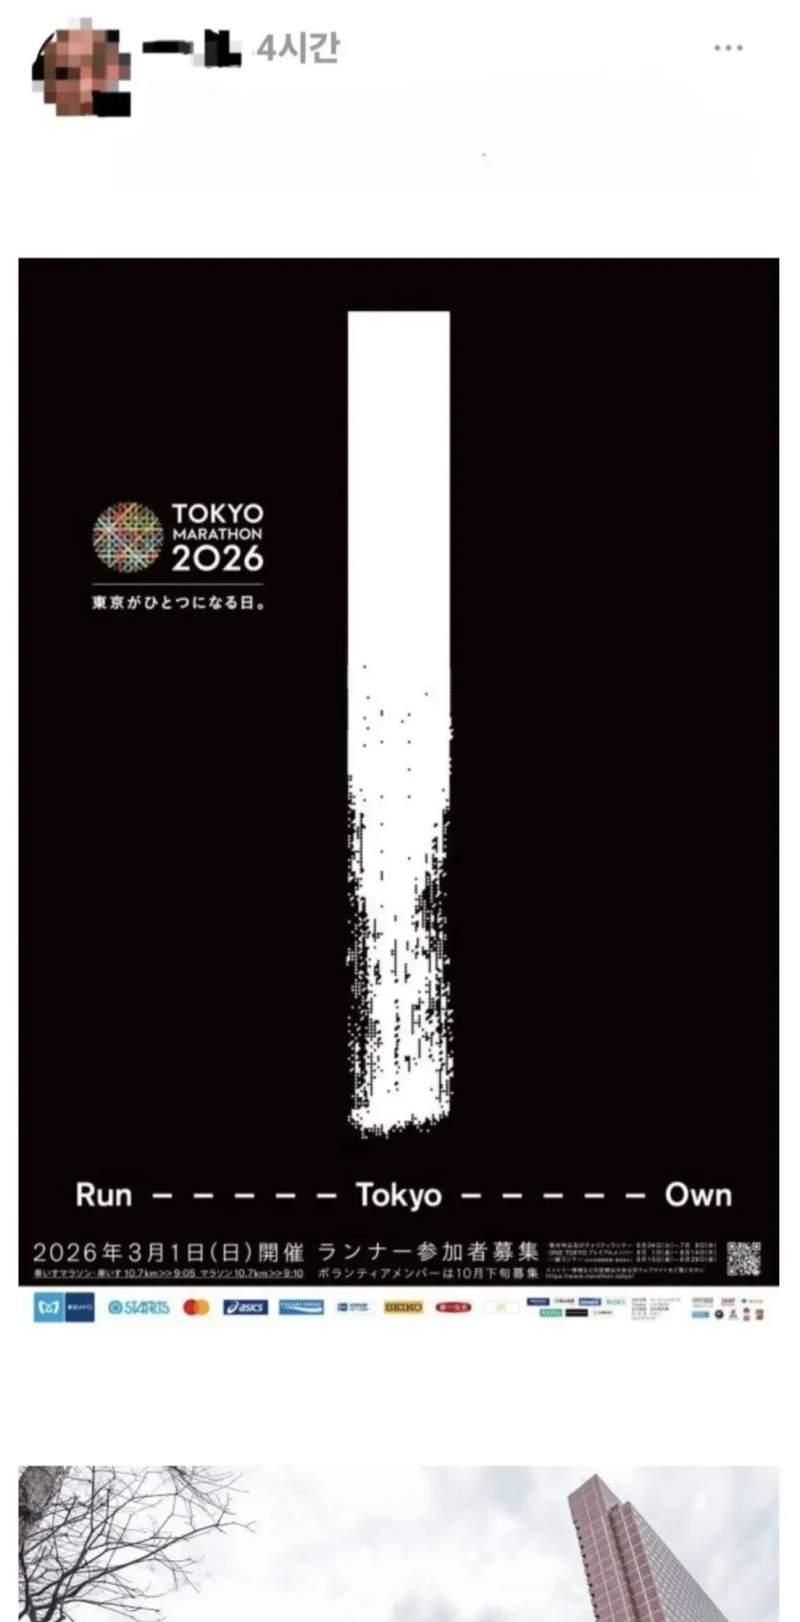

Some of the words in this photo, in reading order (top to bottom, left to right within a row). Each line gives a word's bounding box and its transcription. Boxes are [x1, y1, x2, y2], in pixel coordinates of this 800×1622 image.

[172, 503, 264, 524] TOKYO
[172, 529, 262, 541] MARATHON
[172, 545, 264, 572] 2026
[92, 595, 266, 611] 東京がひとつになる日。
[76, 1182, 132, 1207] Run
[356, 1182, 442, 1212] Tokyo
[665, 1182, 732, 1207] Own
[318, 1241, 539, 1262] ランナー参加者募集
[384, 1302, 423, 1313] SEIKO
